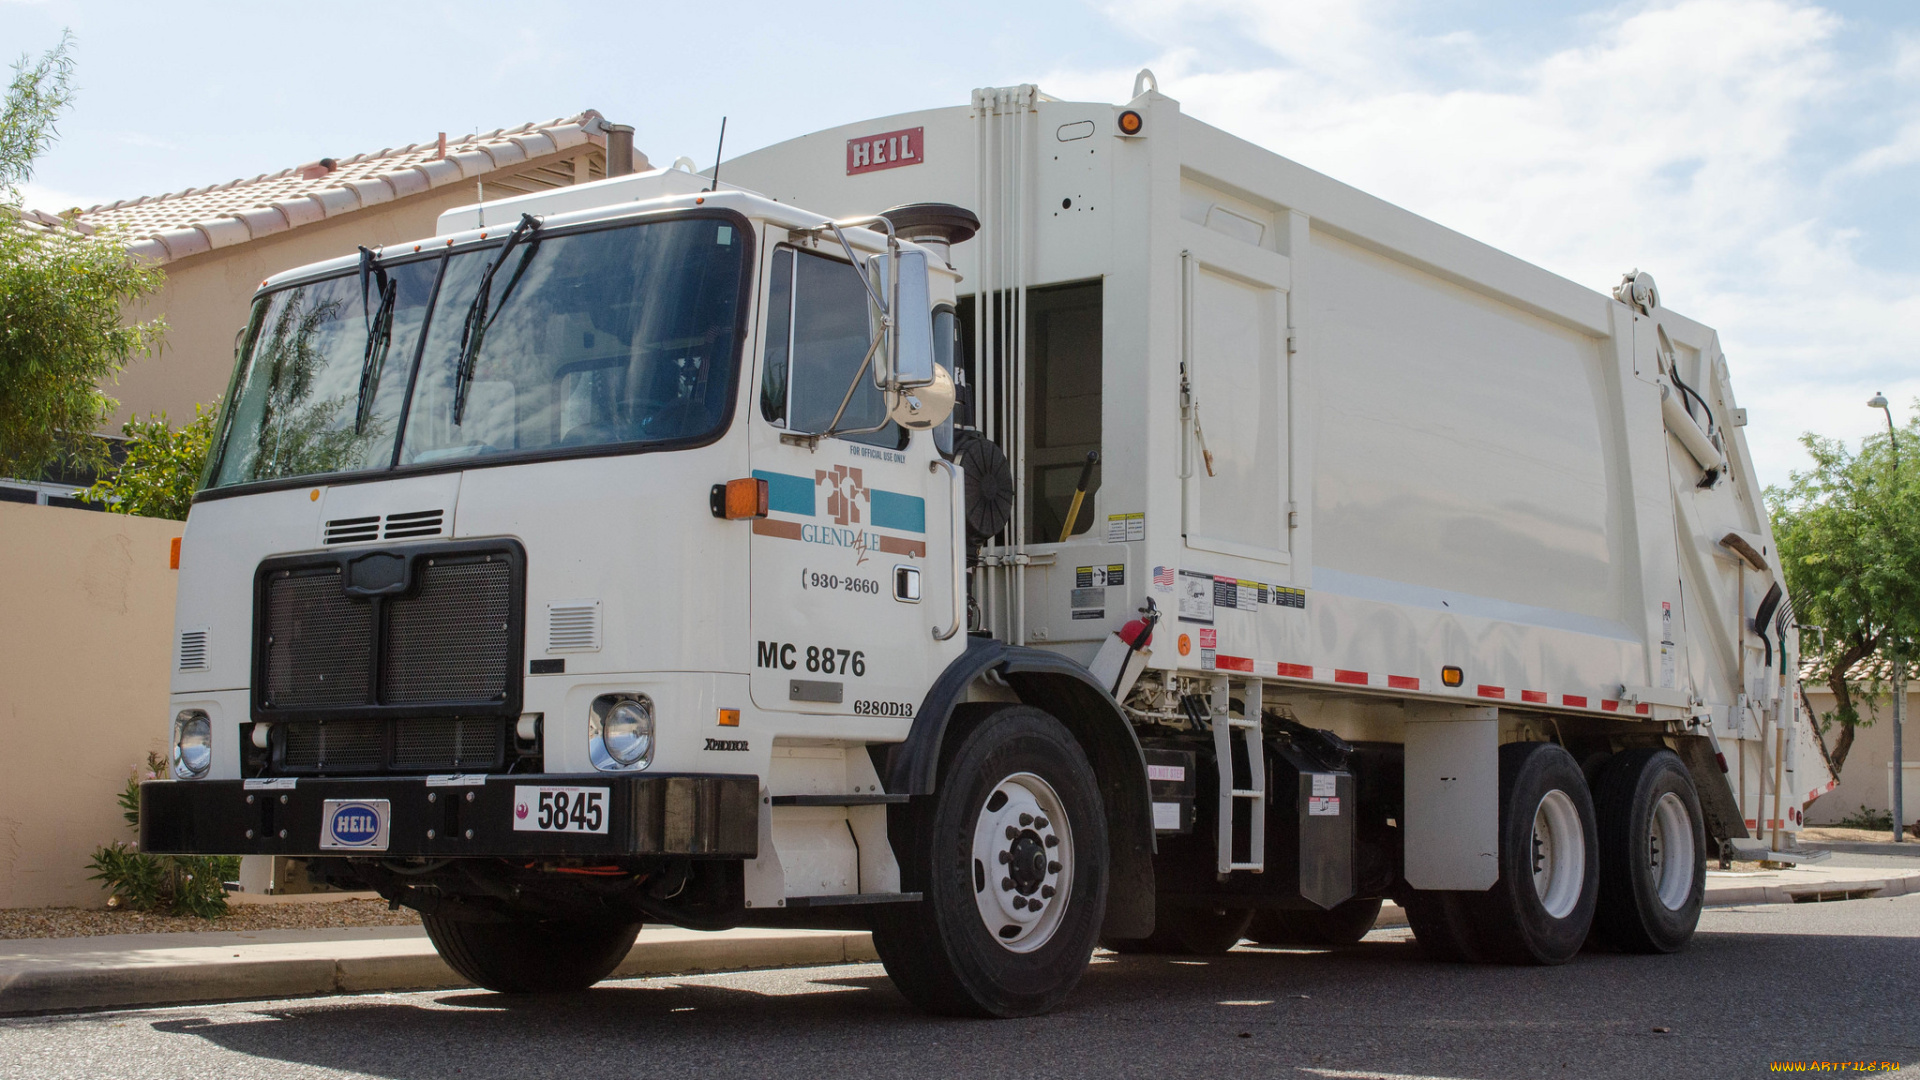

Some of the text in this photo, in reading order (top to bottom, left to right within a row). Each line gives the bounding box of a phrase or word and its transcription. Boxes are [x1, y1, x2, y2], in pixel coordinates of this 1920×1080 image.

[853, 134, 915, 168] HEIL
[850, 445, 906, 464] FOR OFFICIAL USE ONLY
[801, 523, 880, 553] GLENDALE
[757, 640, 866, 677] MC 8876
[853, 699, 913, 717] 6280D13
[337, 815, 375, 833] HEIL
[538, 791, 603, 831] 5845
